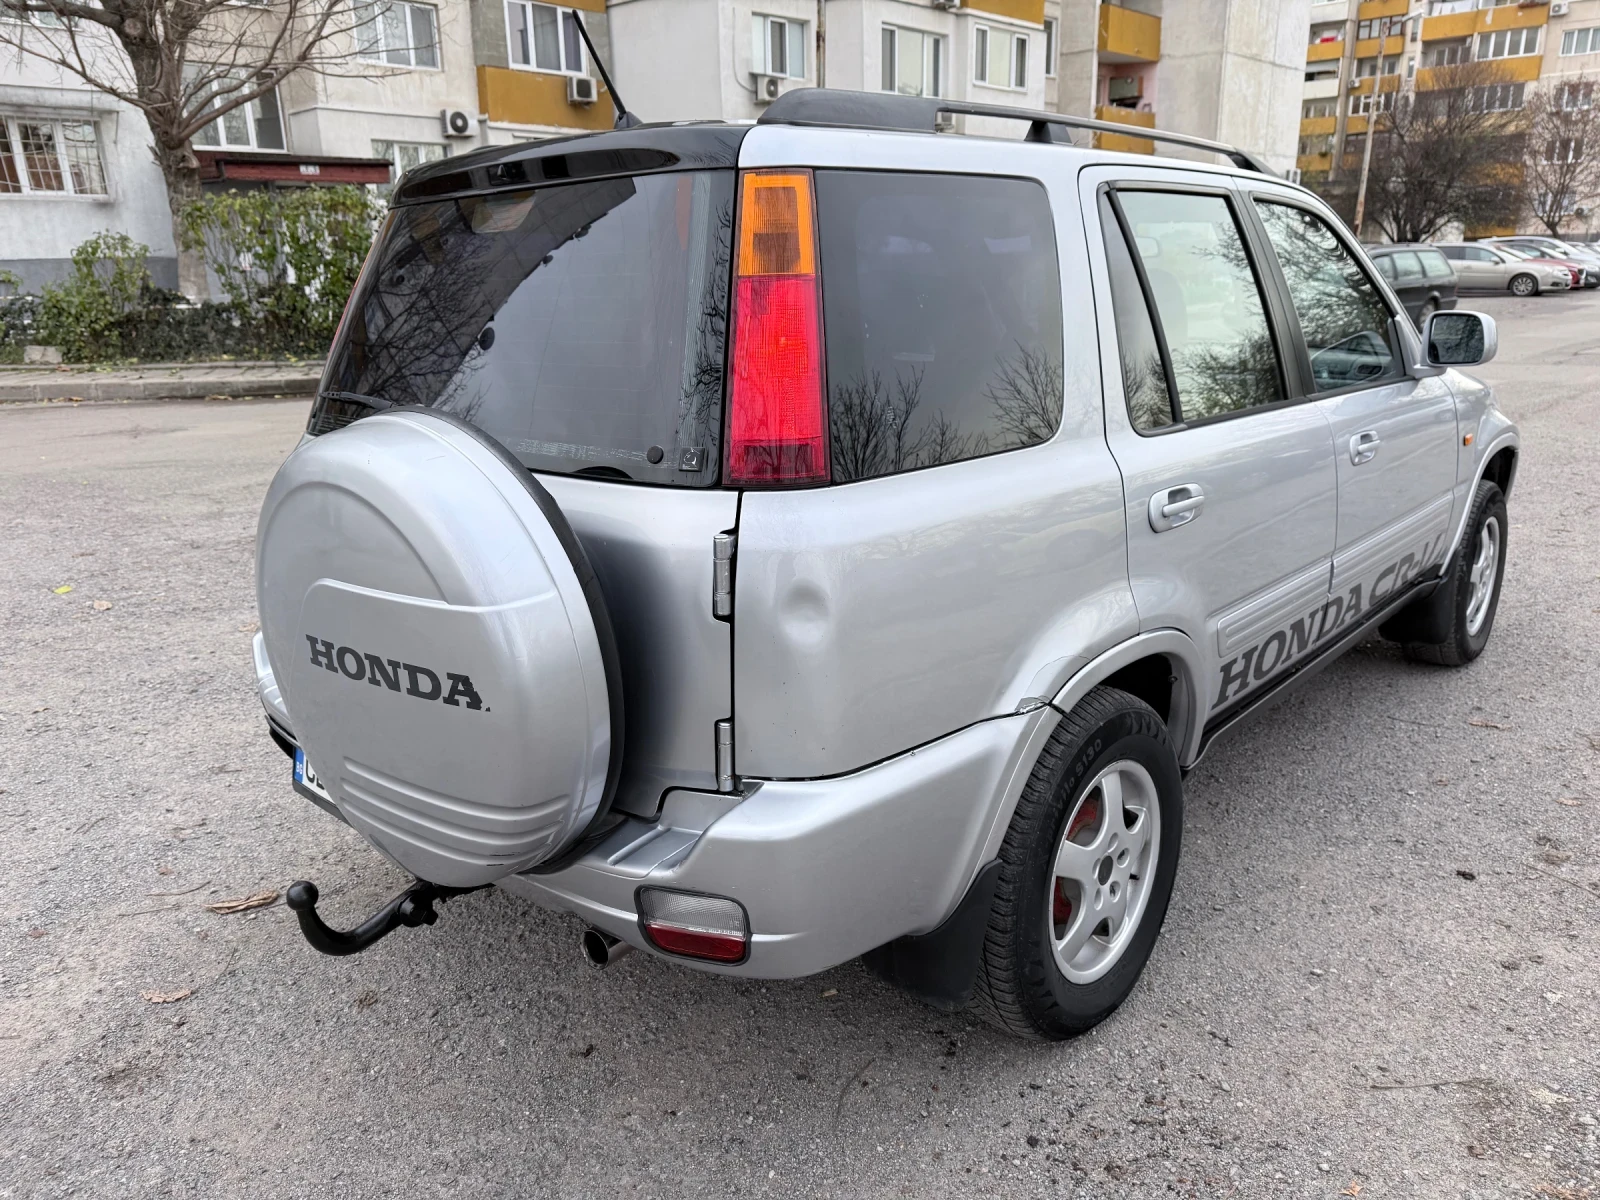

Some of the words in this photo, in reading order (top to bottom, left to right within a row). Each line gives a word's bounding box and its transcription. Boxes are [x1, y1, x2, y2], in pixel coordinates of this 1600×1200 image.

[306, 634, 490, 712] HONDA
[1211, 583, 1363, 710] HONDA
[1075, 738, 1102, 777] S130
